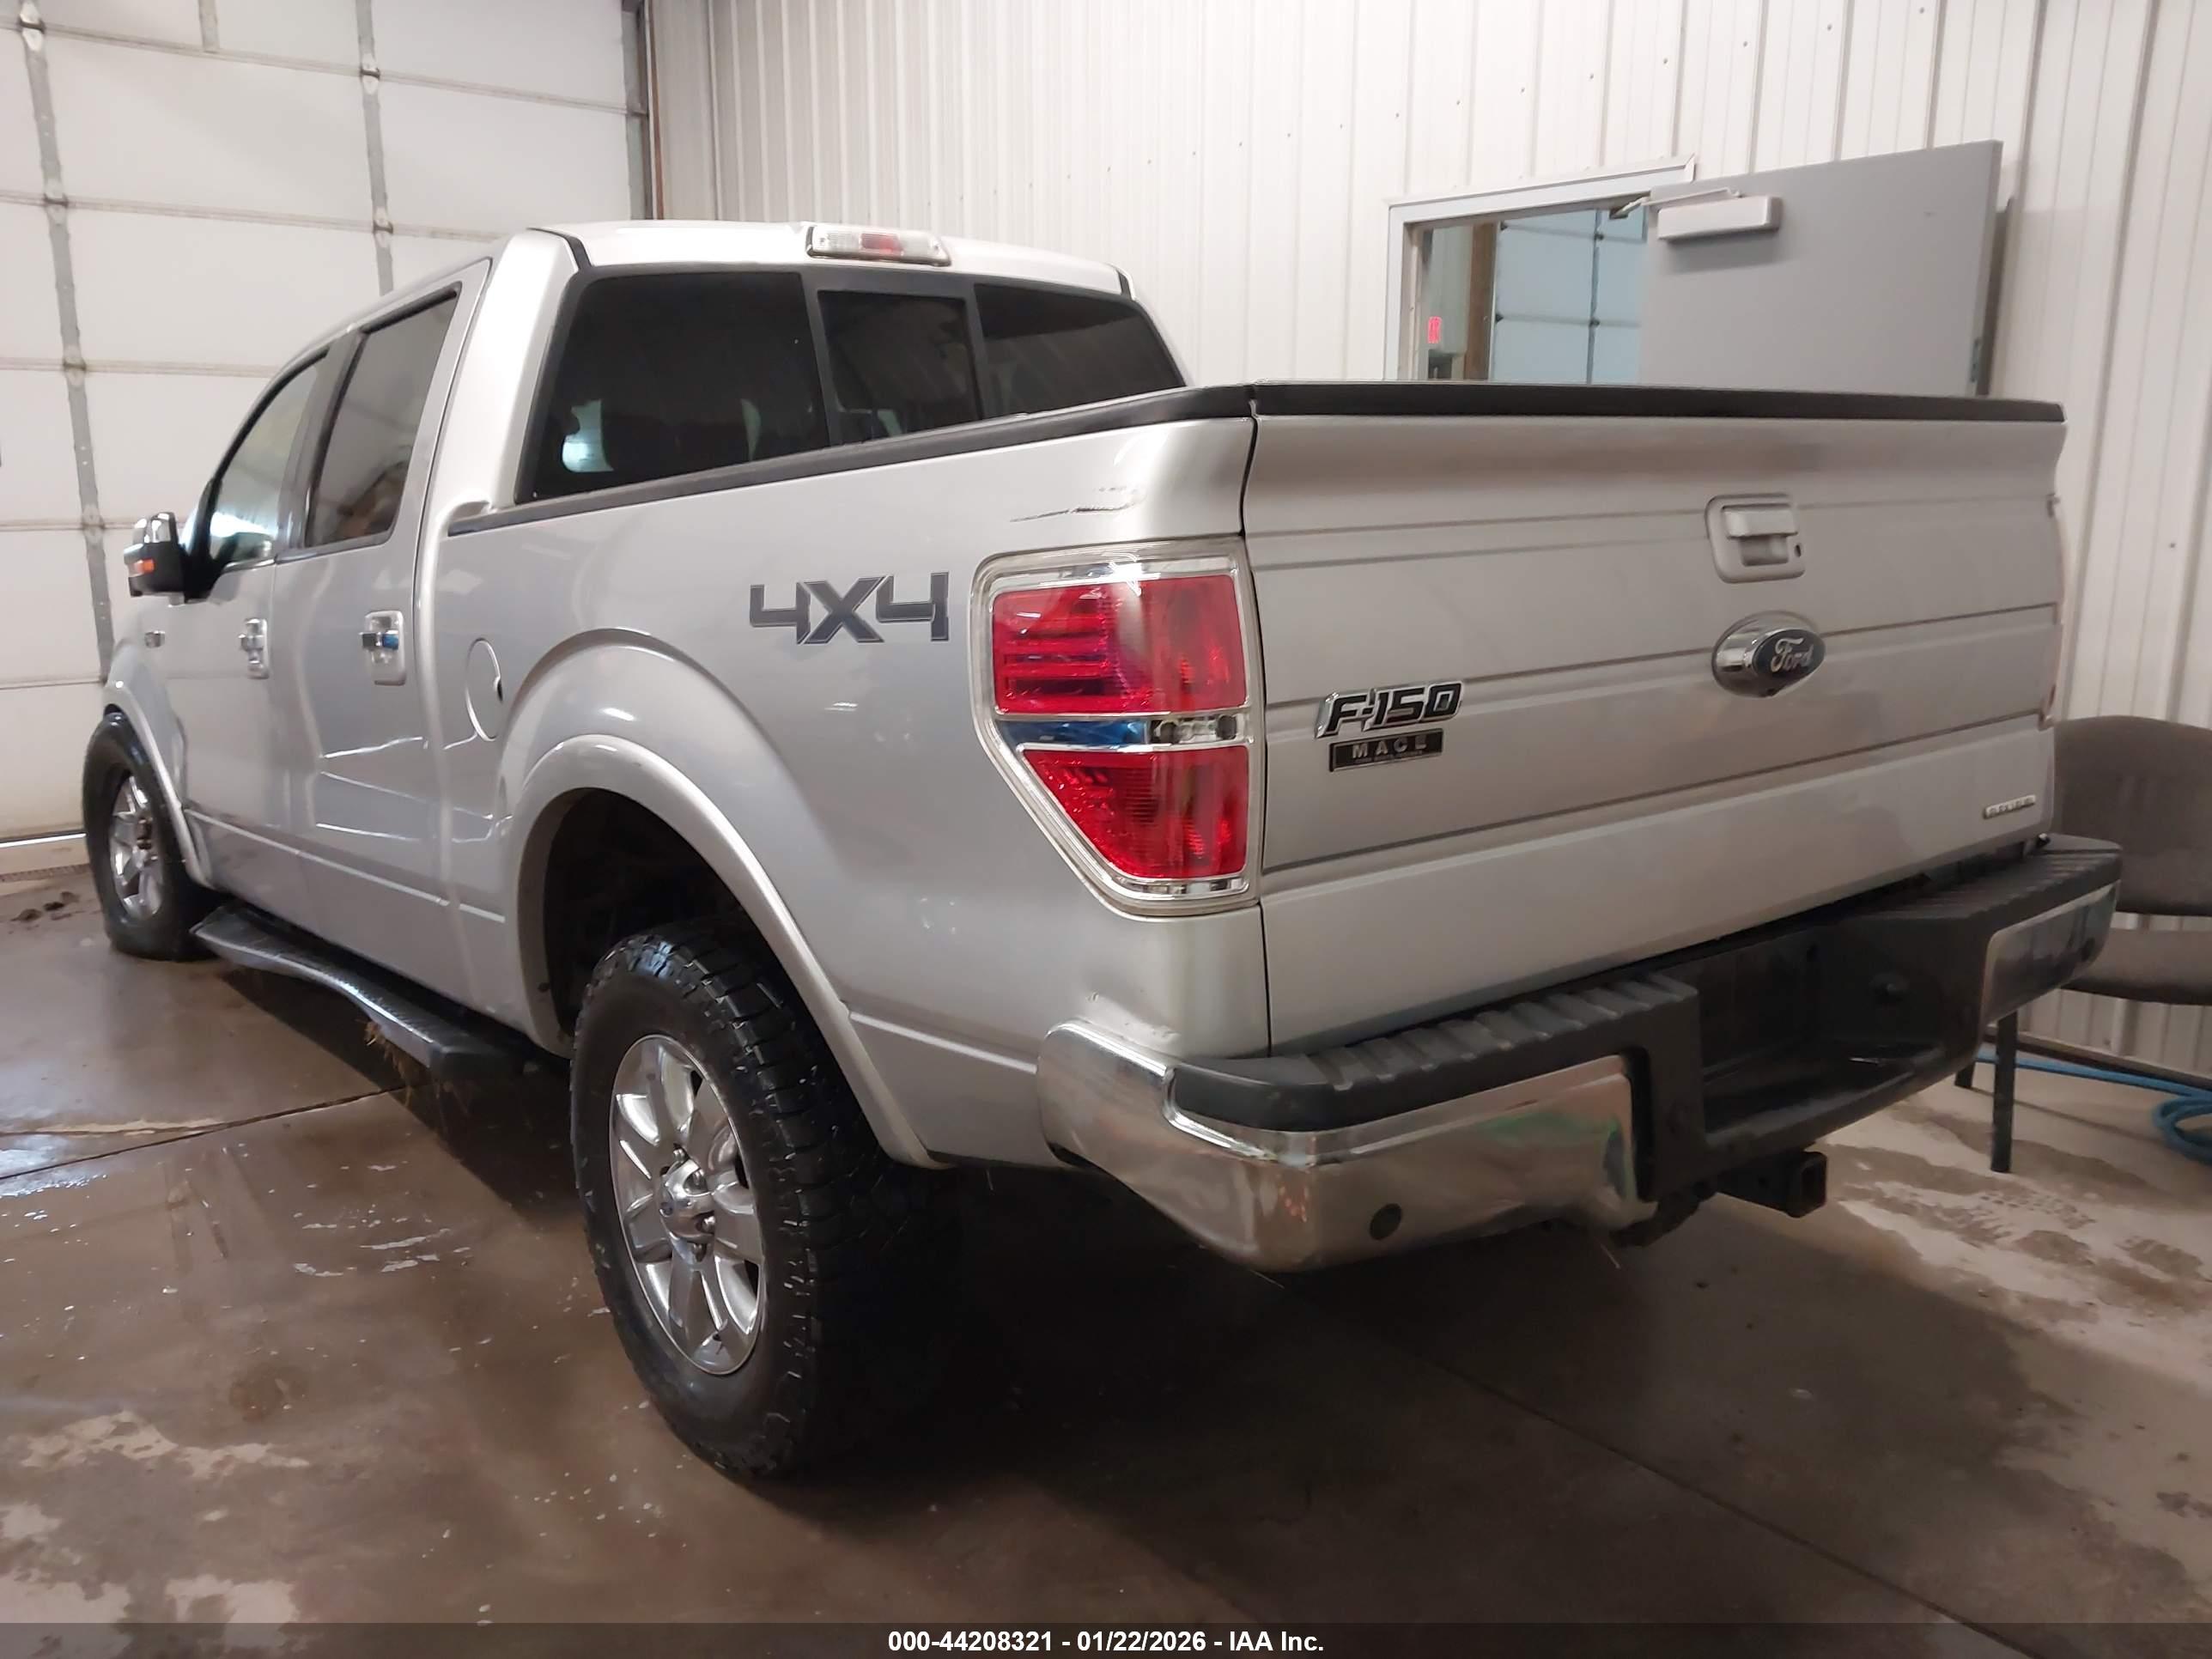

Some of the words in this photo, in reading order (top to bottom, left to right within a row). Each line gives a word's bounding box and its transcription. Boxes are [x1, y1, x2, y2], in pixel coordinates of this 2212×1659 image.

[750, 572, 949, 644] 4X4
[1770, 637, 1814, 672] Ford
[1316, 680, 1465, 738] F-150
